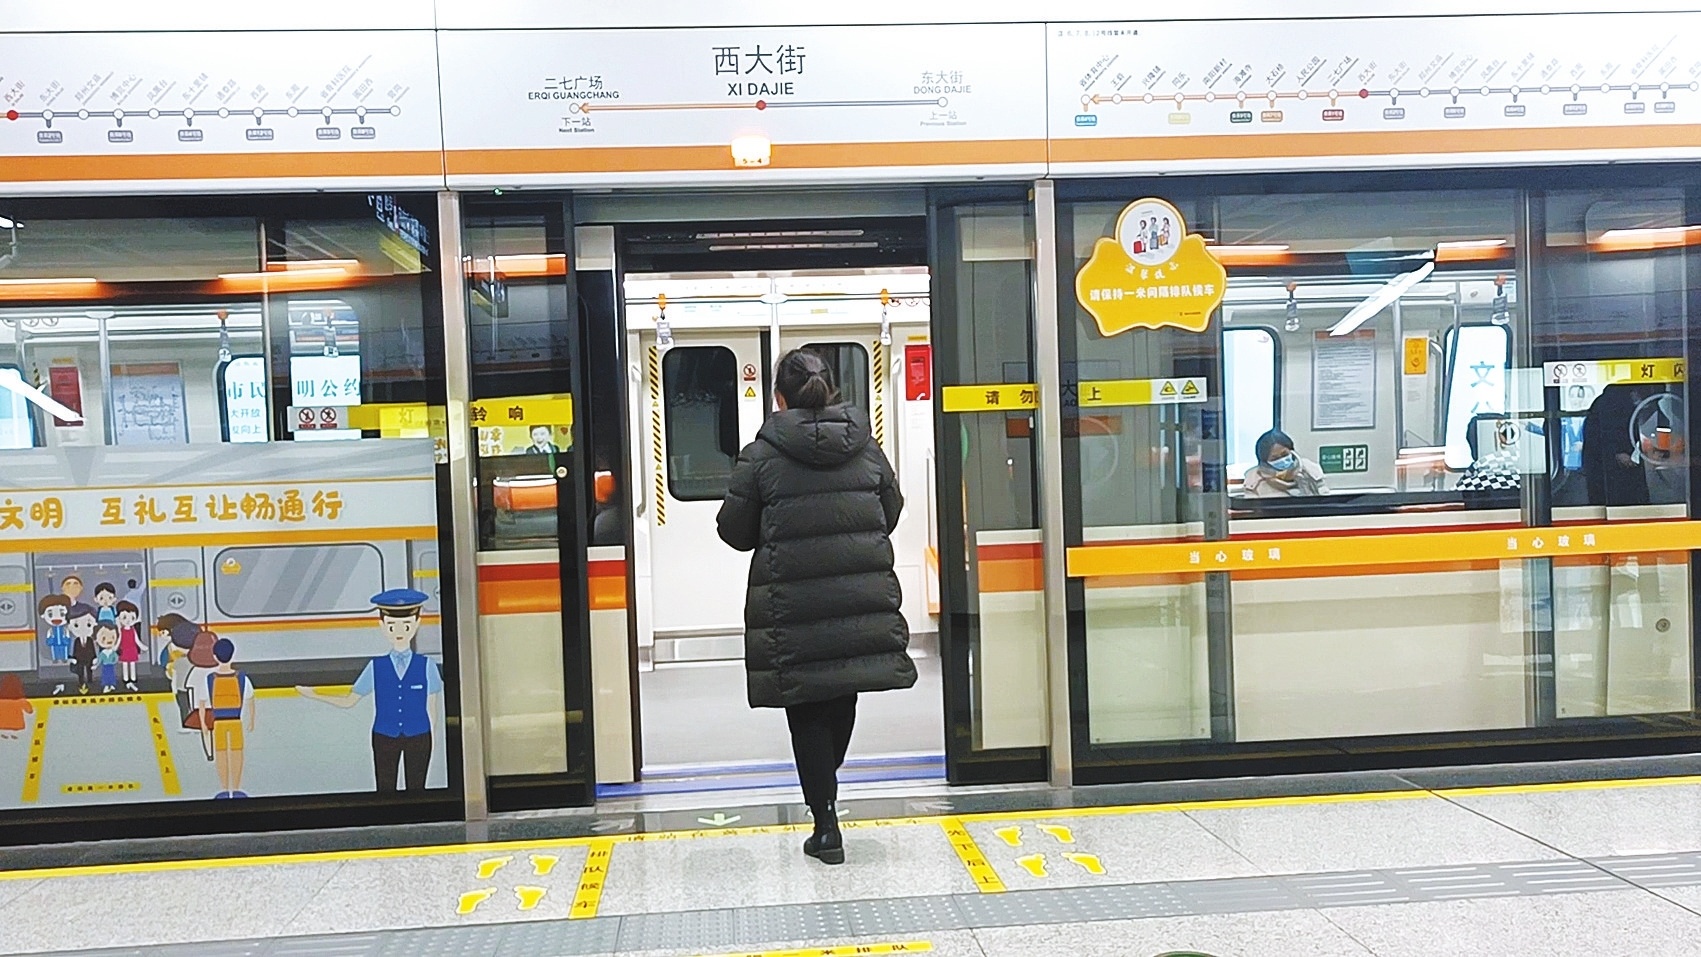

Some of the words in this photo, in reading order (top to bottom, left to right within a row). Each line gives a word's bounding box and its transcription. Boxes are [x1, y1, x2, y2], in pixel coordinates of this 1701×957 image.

[712, 44, 806, 76] 西大街
[920, 69, 964, 84] 东大街
[1296, 55, 1321, 84] 人民公园
[1327, 55, 1352, 84] 二七广场
[1358, 60, 1378, 82] 西大街
[4, 80, 25, 102] 西大街
[544, 75, 603, 90] 二七广场
[727, 82, 742, 96] XI
[747, 82, 795, 96] DAJIE
[913, 85, 942, 94] DONG
[943, 84, 972, 94] DAJIE
[528, 91, 551, 100] ERQI
[552, 91, 620, 100] GUANGCHANG
[561, 117, 592, 127] 下一站
[929, 110, 958, 121] 上一站
[1089, 284, 1216, 301] 请保持一米间隔排队候车
[1469, 361, 1496, 388] 文
[228, 382, 266, 400] 市民
[296, 377, 361, 397] 明公约
[1087, 386, 1102, 401] 上
[985, 388, 1039, 405] 请勿
[399, 408, 414, 424] 灯
[470, 405, 524, 422] 铃响
[0, 497, 63, 530] 文明
[99, 489, 343, 526] 互礼互让畅通行
[1505, 532, 1597, 551] 当心玻璃
[1188, 547, 1281, 564] 当心玻璃
